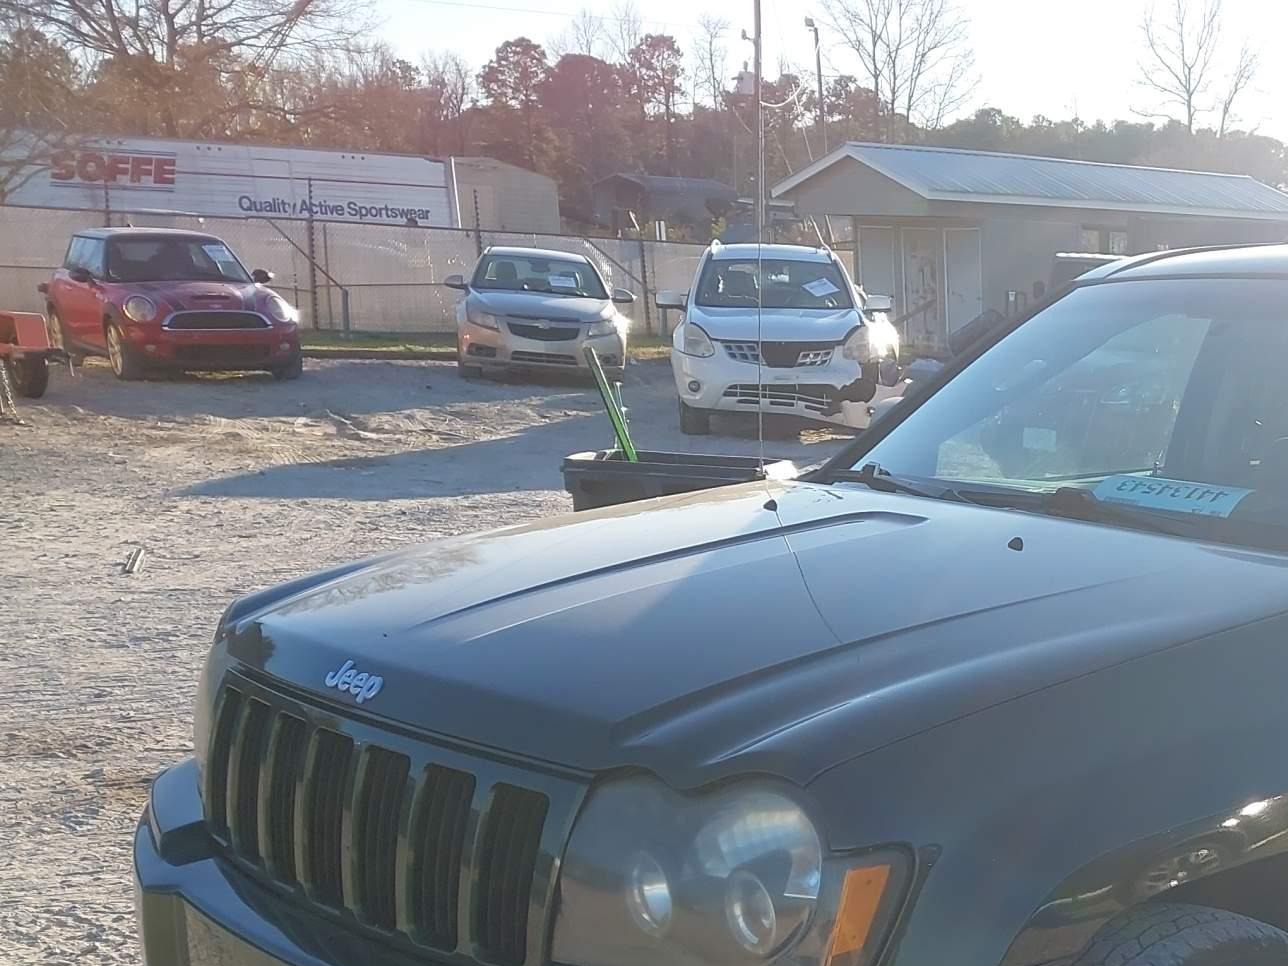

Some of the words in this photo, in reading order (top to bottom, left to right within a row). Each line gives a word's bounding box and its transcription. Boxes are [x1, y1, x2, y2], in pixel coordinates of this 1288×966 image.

[51, 150, 176, 184] SOFFE
[238, 195, 296, 216] Quality
[300, 199, 345, 216] Active
[347, 201, 431, 220] Sportswear
[1115, 479, 1228, 504] 44134543
[325, 660, 383, 703] Jeep
